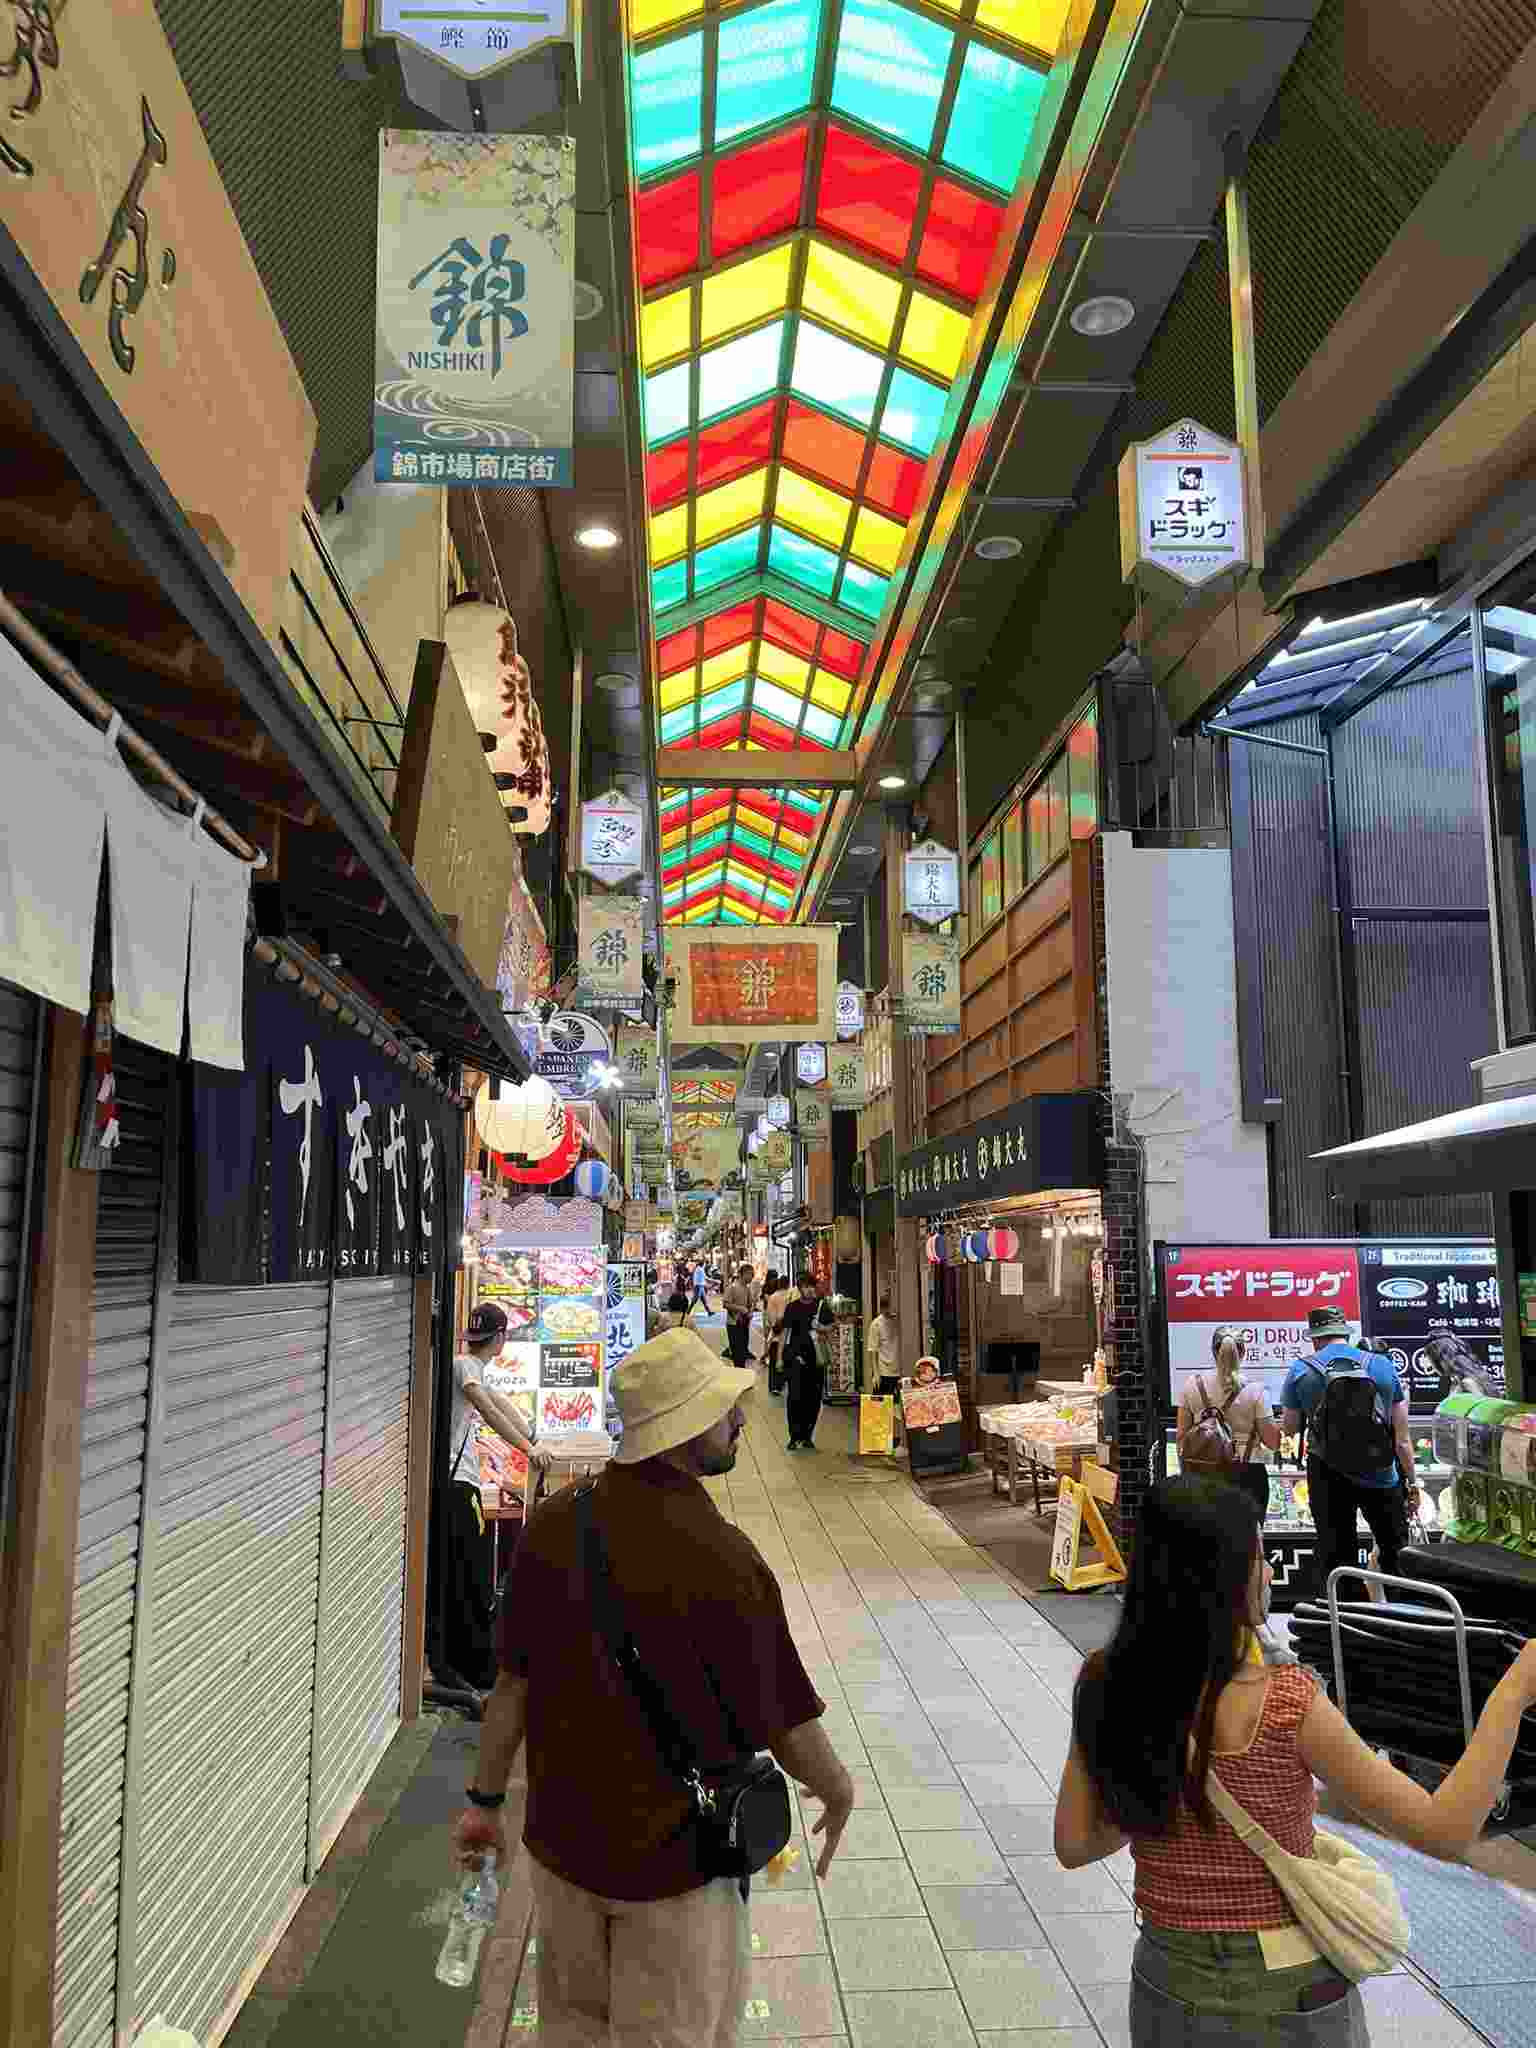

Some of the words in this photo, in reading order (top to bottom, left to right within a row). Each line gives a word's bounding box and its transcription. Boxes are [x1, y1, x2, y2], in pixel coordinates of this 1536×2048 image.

[408, 233, 530, 382] 錦
[408, 352, 485, 371] NISHIKI
[391, 452, 556, 481] 錦市場商店街
[1165, 496, 1217, 516] スギ
[1151, 519, 1236, 539] ドラッグ
[1393, 1250, 1442, 1261] Traditional
[1175, 1269, 1240, 1297] スギ
[1245, 1271, 1352, 1297] ドラッグ
